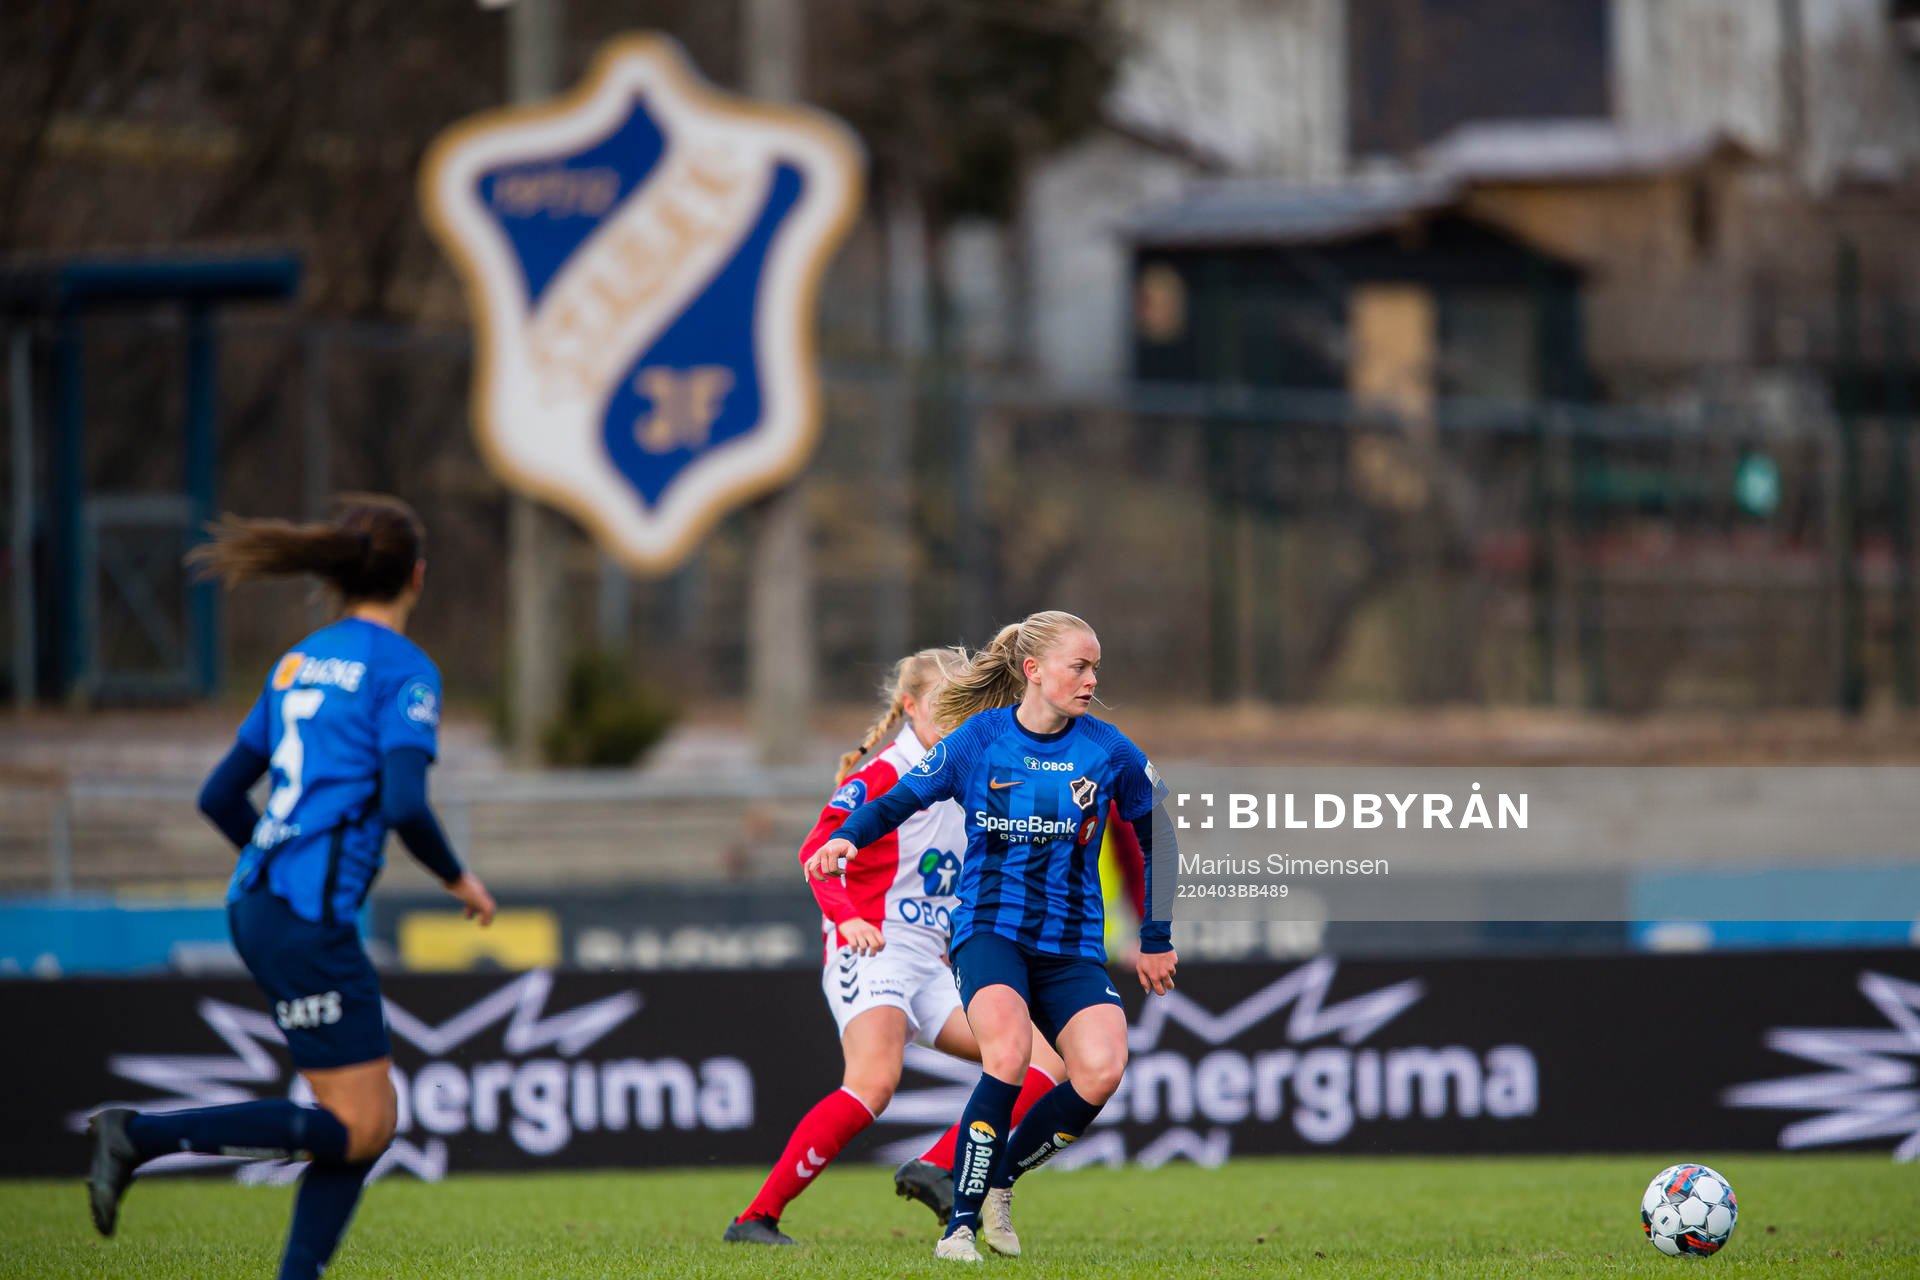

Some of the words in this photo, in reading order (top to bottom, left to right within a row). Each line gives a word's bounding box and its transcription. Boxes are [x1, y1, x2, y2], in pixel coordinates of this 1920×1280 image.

[1041, 761, 1074, 772] OBOS
[975, 810, 1077, 834] SpareBank
[965, 1145, 992, 1196] ARKEL
